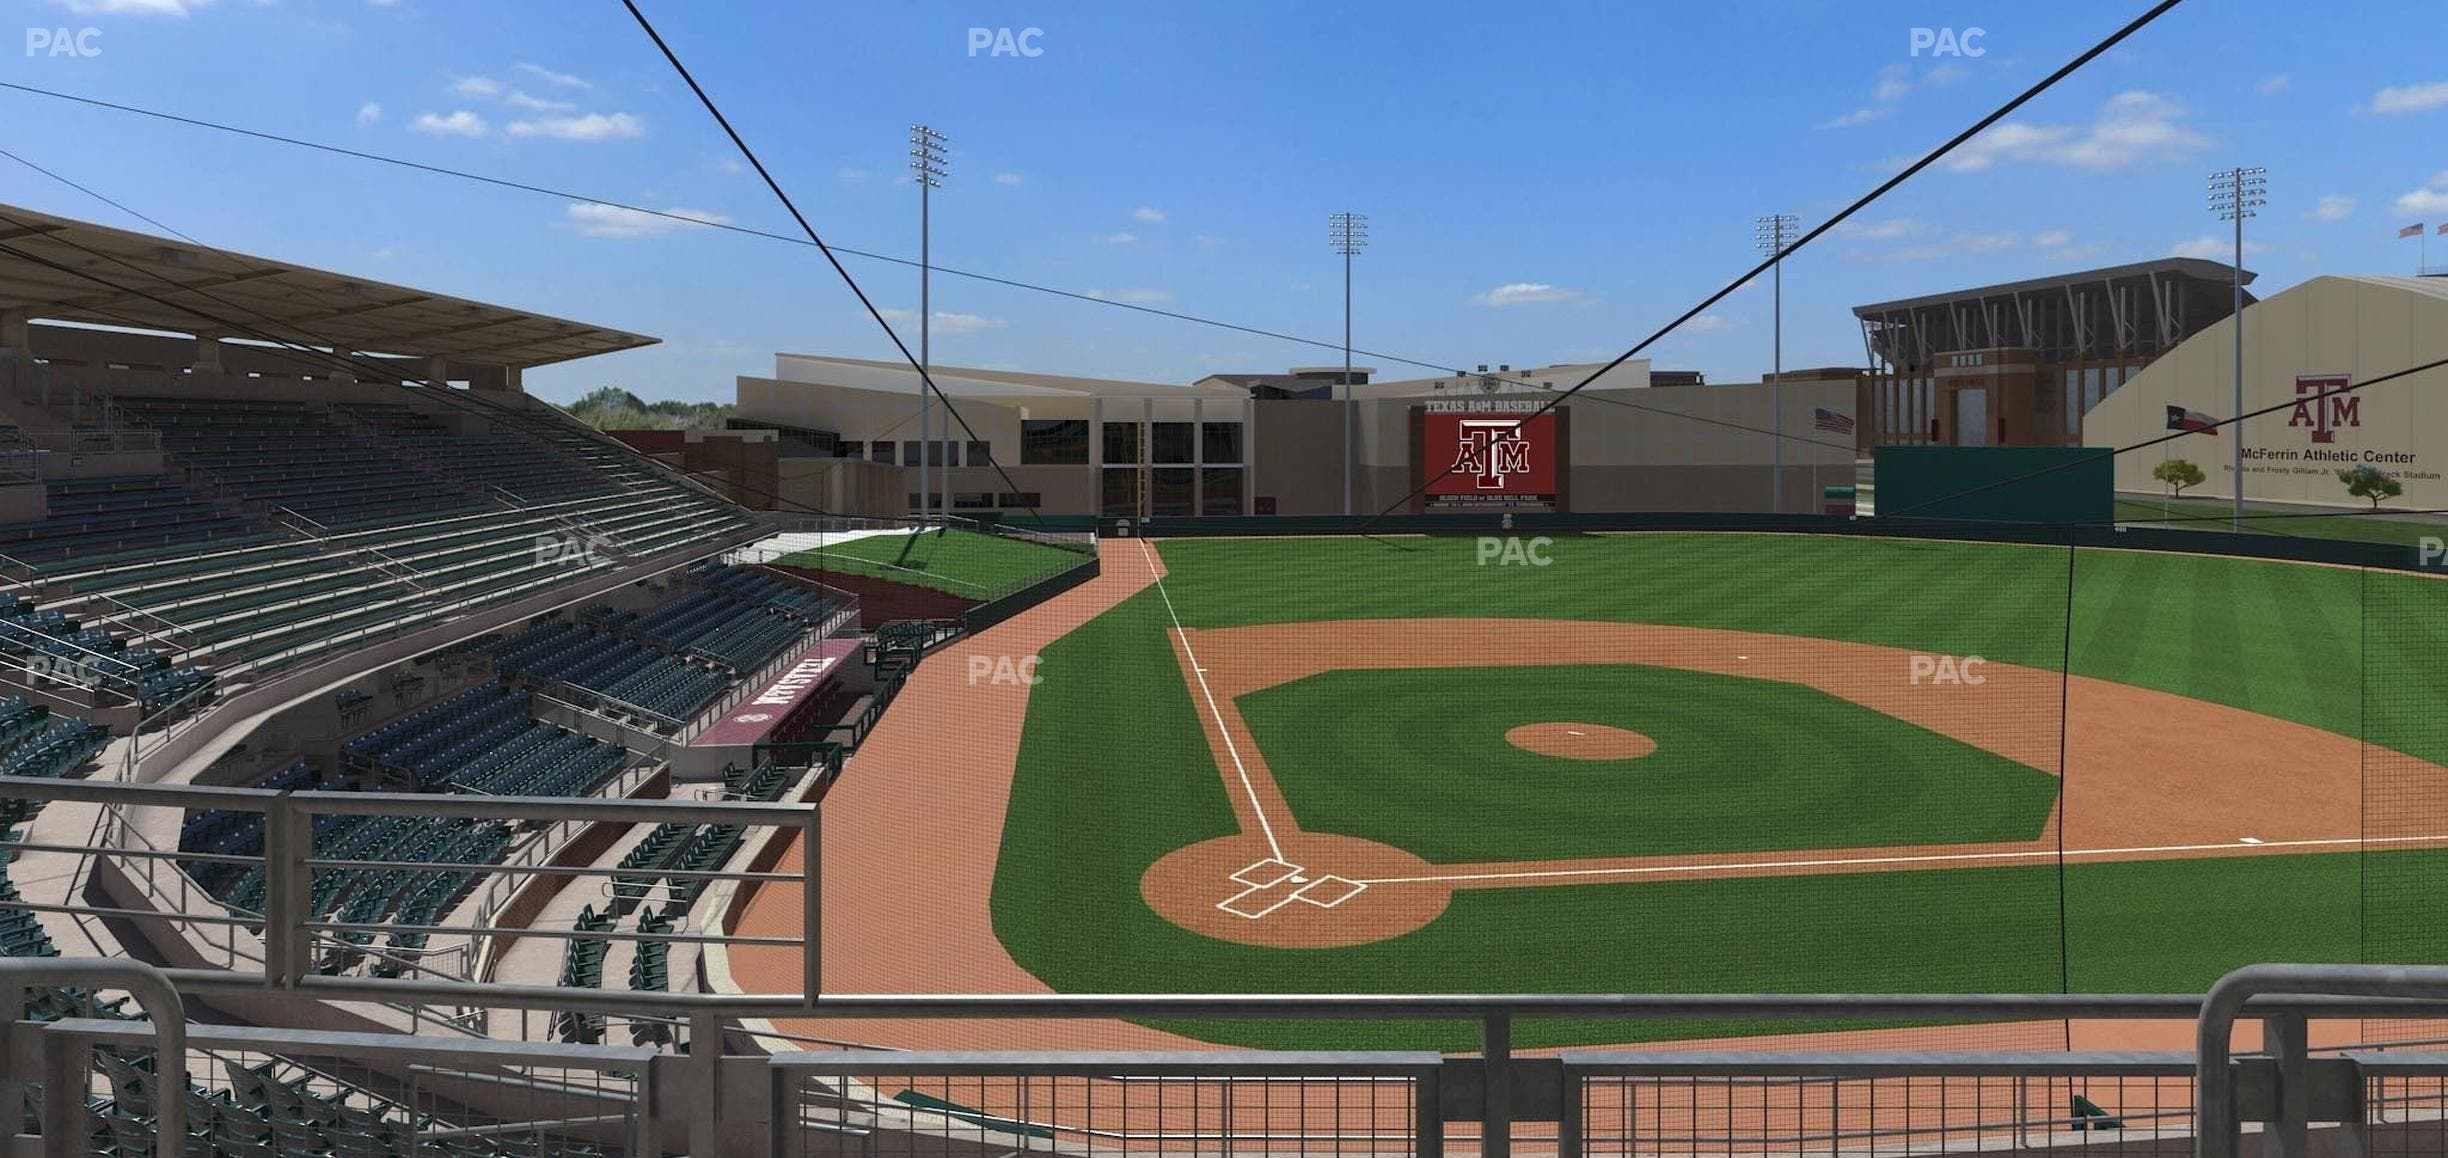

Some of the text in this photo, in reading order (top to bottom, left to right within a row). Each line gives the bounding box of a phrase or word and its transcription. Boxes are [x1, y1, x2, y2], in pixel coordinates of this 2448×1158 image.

[1425, 400, 1465, 413] TEXAS
[1495, 400, 1555, 413] BASEBALL
[2241, 447, 2416, 463] McFerrin Athletic Center
[2267, 466, 2290, 475] Frosty
[2403, 471, 2441, 480] Stadium
